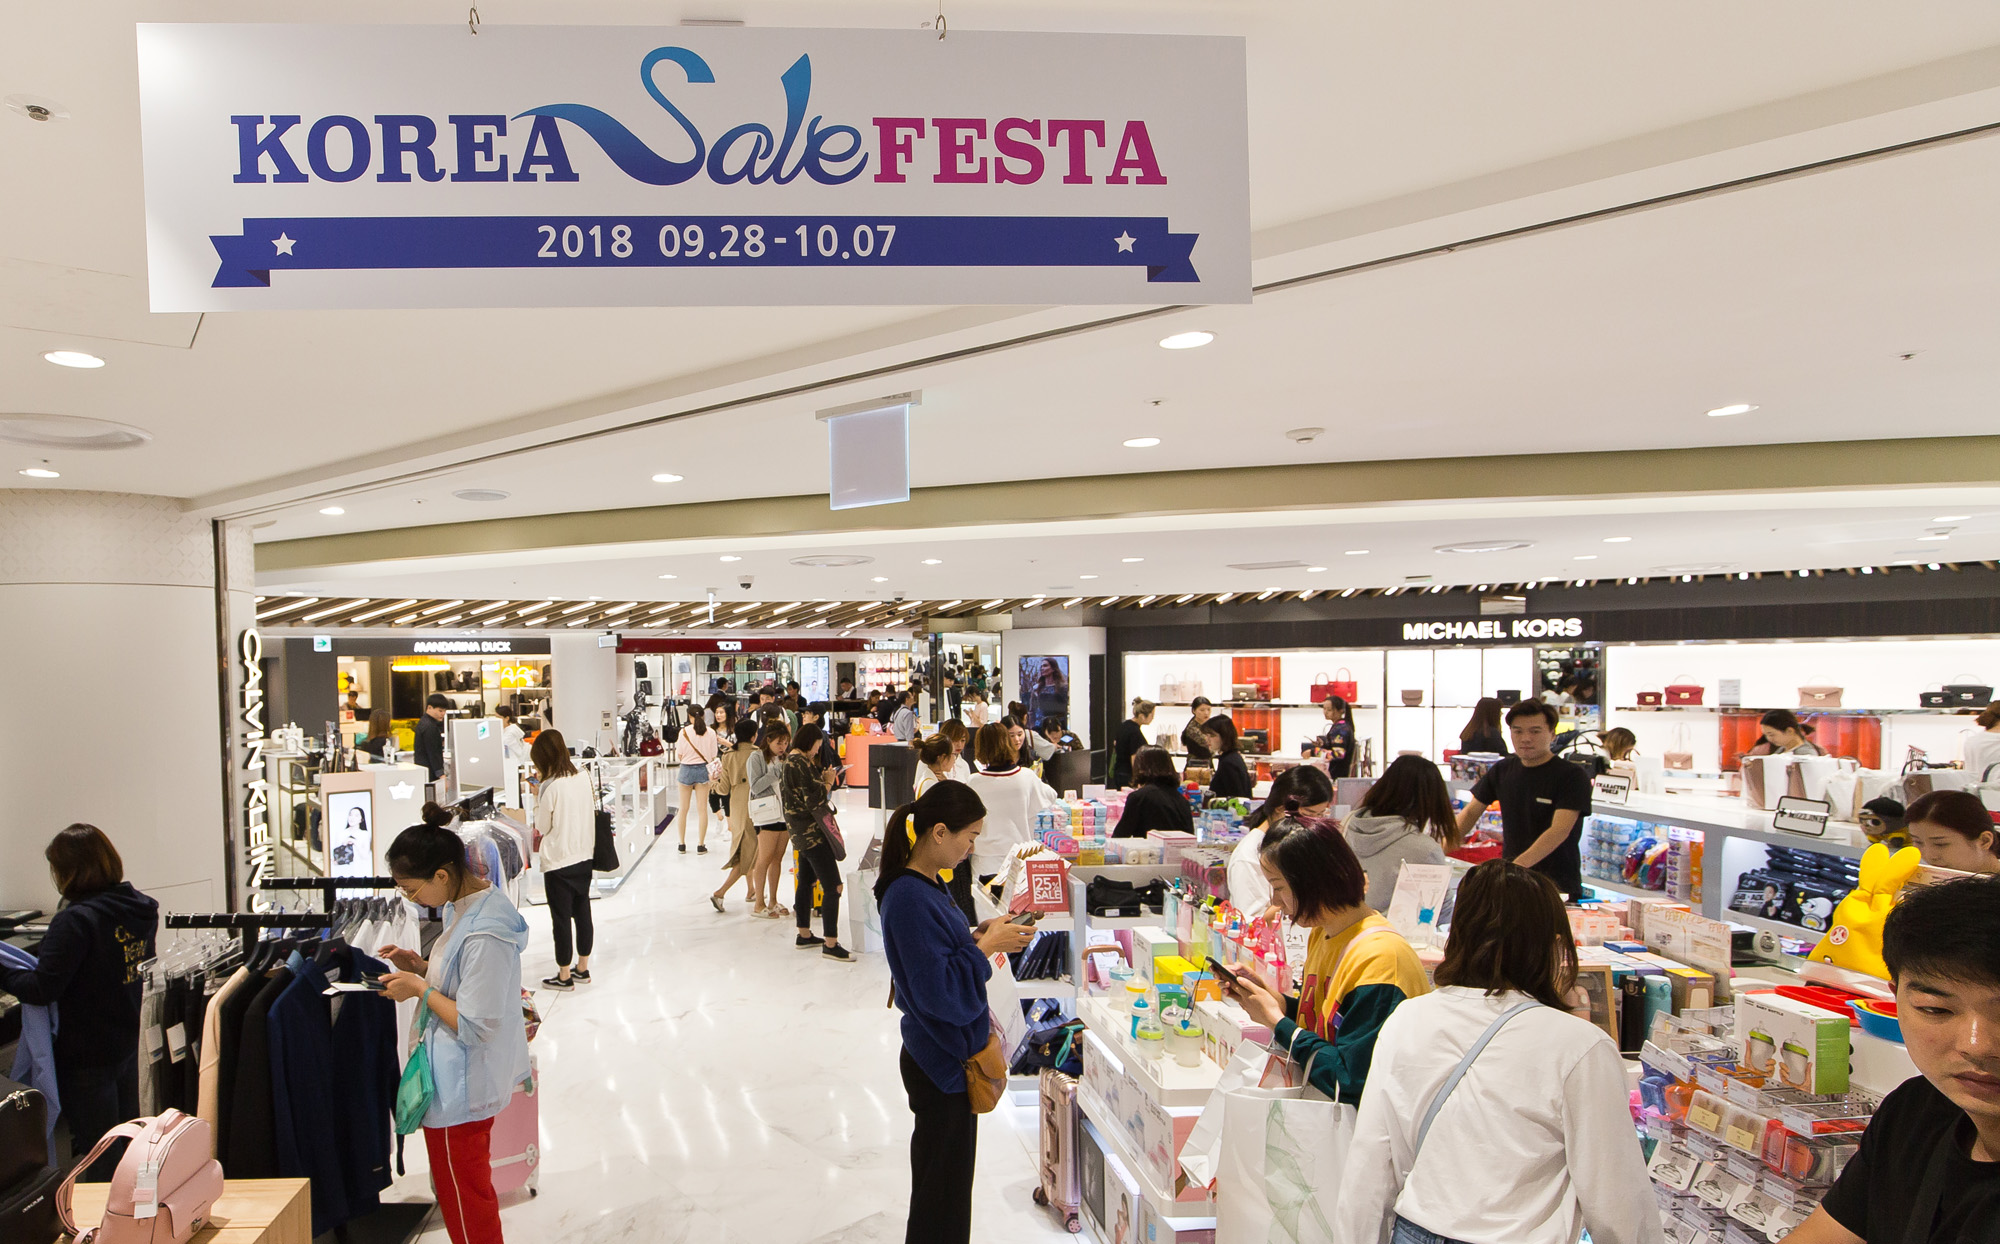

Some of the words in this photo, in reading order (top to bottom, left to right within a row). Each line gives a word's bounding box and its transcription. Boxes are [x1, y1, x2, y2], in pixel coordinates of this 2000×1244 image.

[231, 115, 579, 184] KOREA
[511, 46, 868, 186] Sale
[872, 118, 1168, 185] FESTA
[537, 224, 634, 259] 2018
[1402, 618, 1507, 642] MICHAEL
[1512, 617, 1584, 639] KORS
[481, 641, 512, 653] DUCK
[243, 628, 265, 770] CALVIN
[248, 778, 269, 888] KLEIN
[1035, 877, 1060, 891] 25%
[1035, 890, 1061, 900] SALE
[1285, 934, 1304, 943] 2+1
